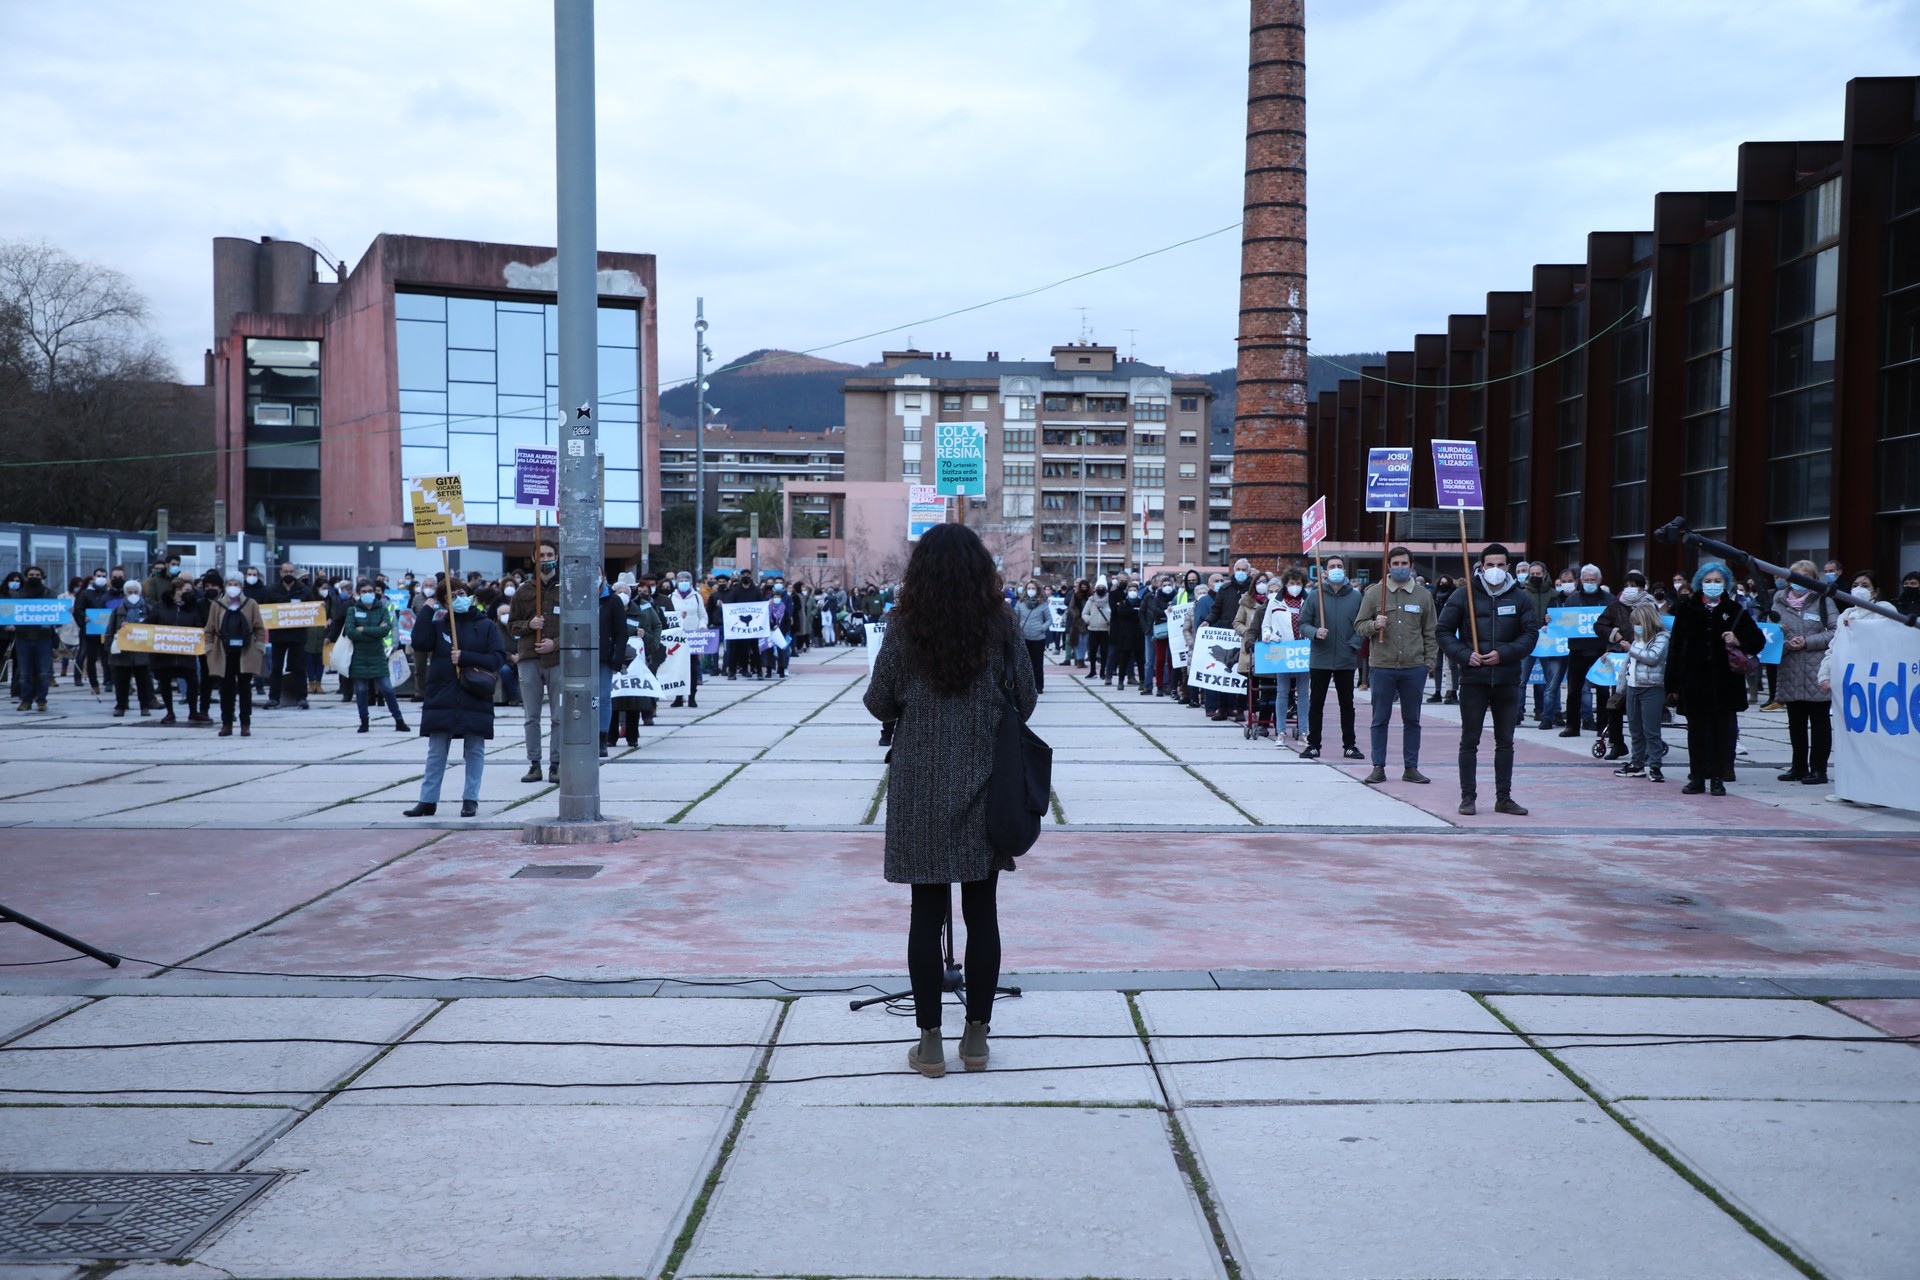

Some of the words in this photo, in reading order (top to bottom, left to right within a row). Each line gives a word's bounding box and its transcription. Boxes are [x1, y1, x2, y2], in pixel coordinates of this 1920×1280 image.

[937, 426, 969, 437] LOLA
[937, 437, 976, 448] LOPEZ
[937, 447, 982, 458] RESINA
[1387, 453, 1408, 461] JOSU
[436, 477, 461, 486] GITA
[1369, 473, 1380, 487] 7
[15, 602, 66, 614] presoak
[278, 607, 319, 619] presoak
[15, 613, 60, 622] etxera!
[278, 616, 315, 626] etxera!
[731, 626, 764, 634] ETXERA
[154, 633, 201, 643] presoak
[661, 635, 687, 643] SOAK
[153, 642, 195, 653] etxera!
[1285, 646, 1311, 660] pre
[1196, 671, 1248, 688] ETXERA
